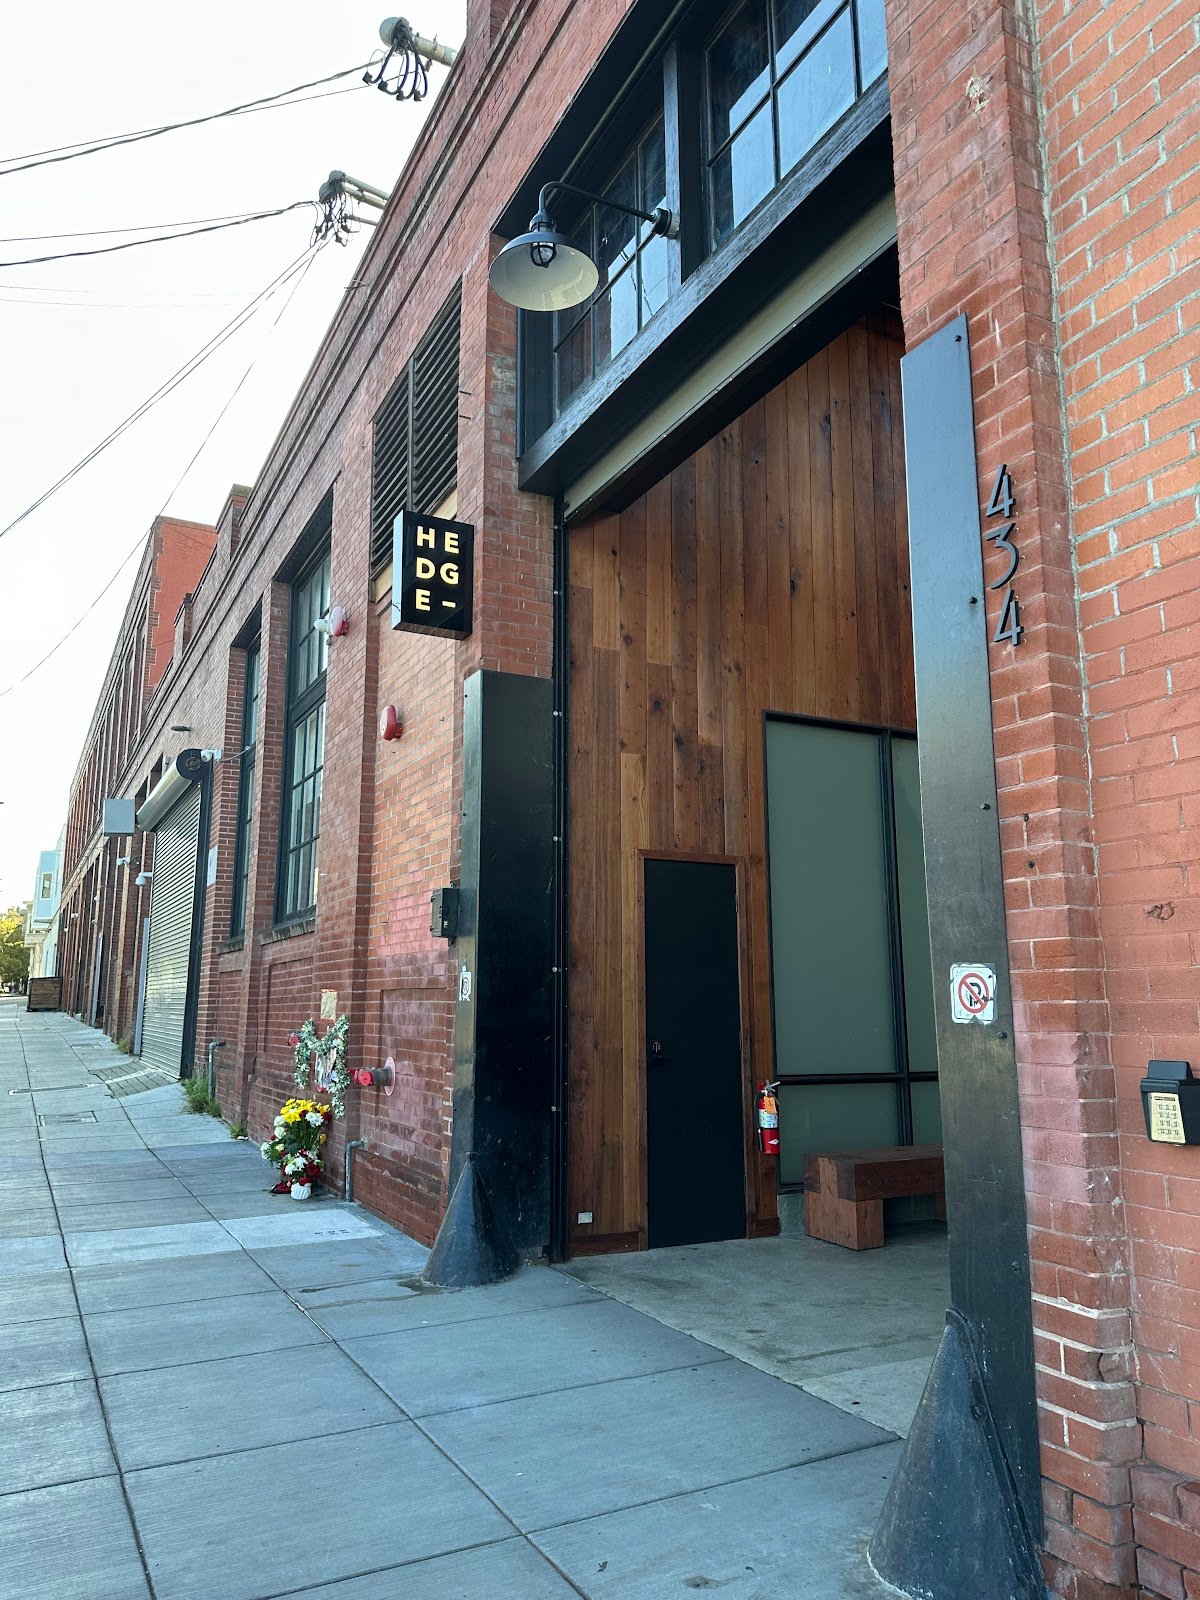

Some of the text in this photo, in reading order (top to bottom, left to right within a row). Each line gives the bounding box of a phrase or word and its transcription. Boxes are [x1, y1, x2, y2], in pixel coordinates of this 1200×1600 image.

[417, 525, 459, 554] HE
[984, 463, 1025, 647] 434
[416, 556, 459, 585] DG
